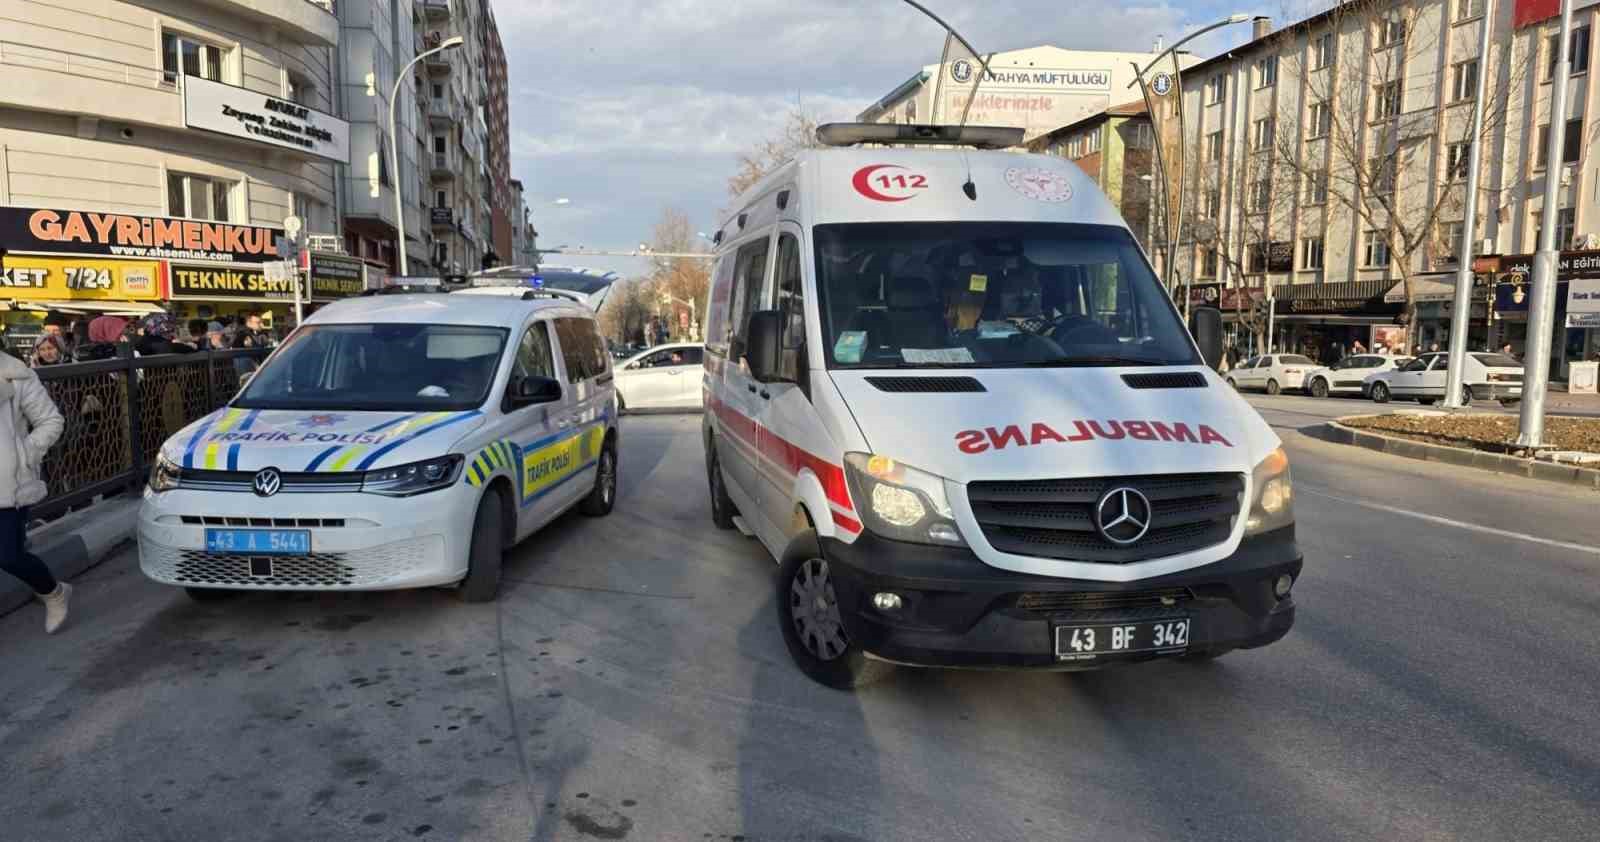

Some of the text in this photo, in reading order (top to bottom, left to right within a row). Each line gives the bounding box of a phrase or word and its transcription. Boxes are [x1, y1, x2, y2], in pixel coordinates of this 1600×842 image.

[876, 175, 929, 188] 112
[29, 209, 278, 255] GAYRİMENKUL
[64, 267, 112, 291] 7/24
[176, 270, 244, 290] TEKNİK
[209, 430, 296, 443] TRAFİK
[215, 531, 306, 551] 43 A 5441
[1070, 621, 1186, 651] 43 BF 342
